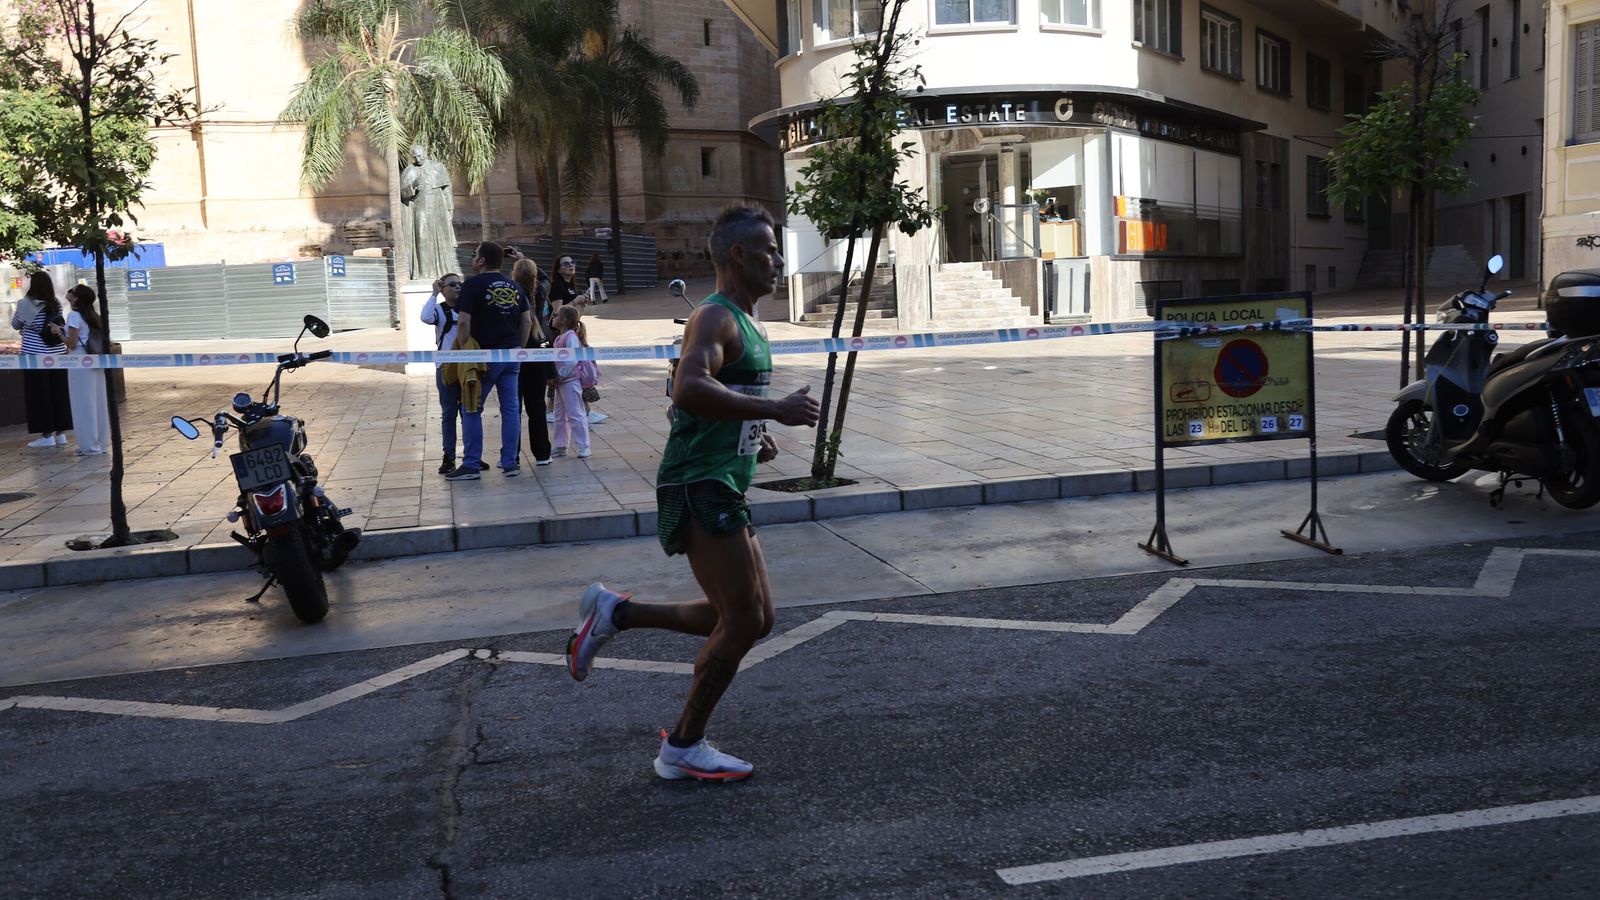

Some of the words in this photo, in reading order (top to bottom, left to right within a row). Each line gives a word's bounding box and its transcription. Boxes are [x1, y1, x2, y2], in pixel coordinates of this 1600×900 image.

[882, 107, 935, 127] EAL
[946, 103, 1026, 123] ESTATE
[1223, 309, 1265, 321] LOCAL
[1166, 406, 1215, 421] PROHIBIDO
[1217, 402, 1272, 418] ESTACIONAR
[1167, 423, 1184, 437] LAS
[1190, 424, 1202, 433] 23
[1221, 420, 1239, 432] DEL
[1262, 419, 1274, 429] 26
[1290, 418, 1302, 427] 27
[246, 448, 282, 469] 6492
